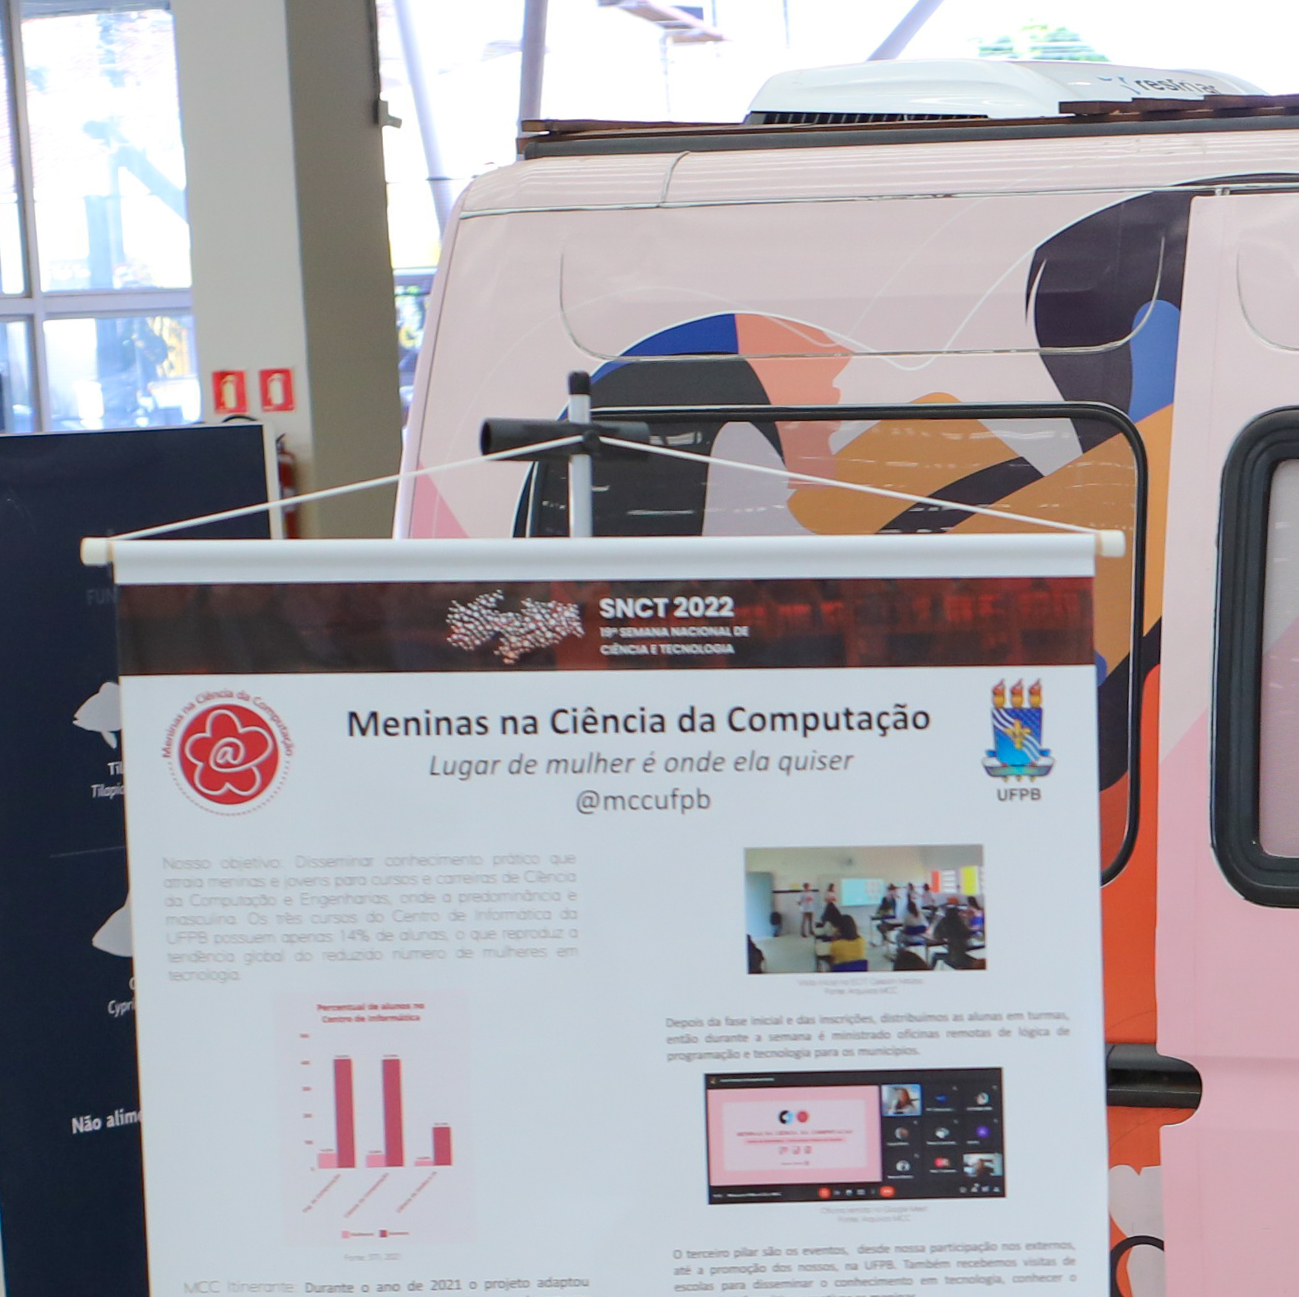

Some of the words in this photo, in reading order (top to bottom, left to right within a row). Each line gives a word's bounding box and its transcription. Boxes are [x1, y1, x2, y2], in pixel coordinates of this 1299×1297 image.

[599, 597, 669, 619] SNCT
[673, 596, 735, 618] 2022
[619, 626, 670, 638] SEMANA
[670, 626, 732, 637] NACIONAL
[733, 626, 750, 637] DE
[599, 642, 649, 655] CIÊNCIA
[650, 644, 659, 655] E
[659, 644, 735, 655] TECNOLOGIA
[162, 715, 184, 758] Meninas
[182, 702, 196, 714] na
[236, 690, 251, 701] da
[253, 697, 295, 756] Computação
[348, 710, 489, 737] Meninas
[500, 714, 539, 736] na
[550, 708, 667, 735] Ciência
[677, 707, 716, 734] da
[727, 704, 931, 738] Computação
[429, 754, 500, 781] Lugar
[508, 753, 538, 775] de
[546, 752, 632, 774] mulher
[643, 752, 656, 773] é
[665, 751, 726, 773] onde
[734, 751, 770, 772] ela
[778, 750, 854, 777] quiser
[575, 788, 712, 814] @mccufpb
[997, 787, 1042, 801] UFPB
[321, 1015, 353, 1024] Centro
[354, 1014, 366, 1023] de
[367, 1013, 421, 1022] Informática
[71, 1115, 102, 1134] Não
